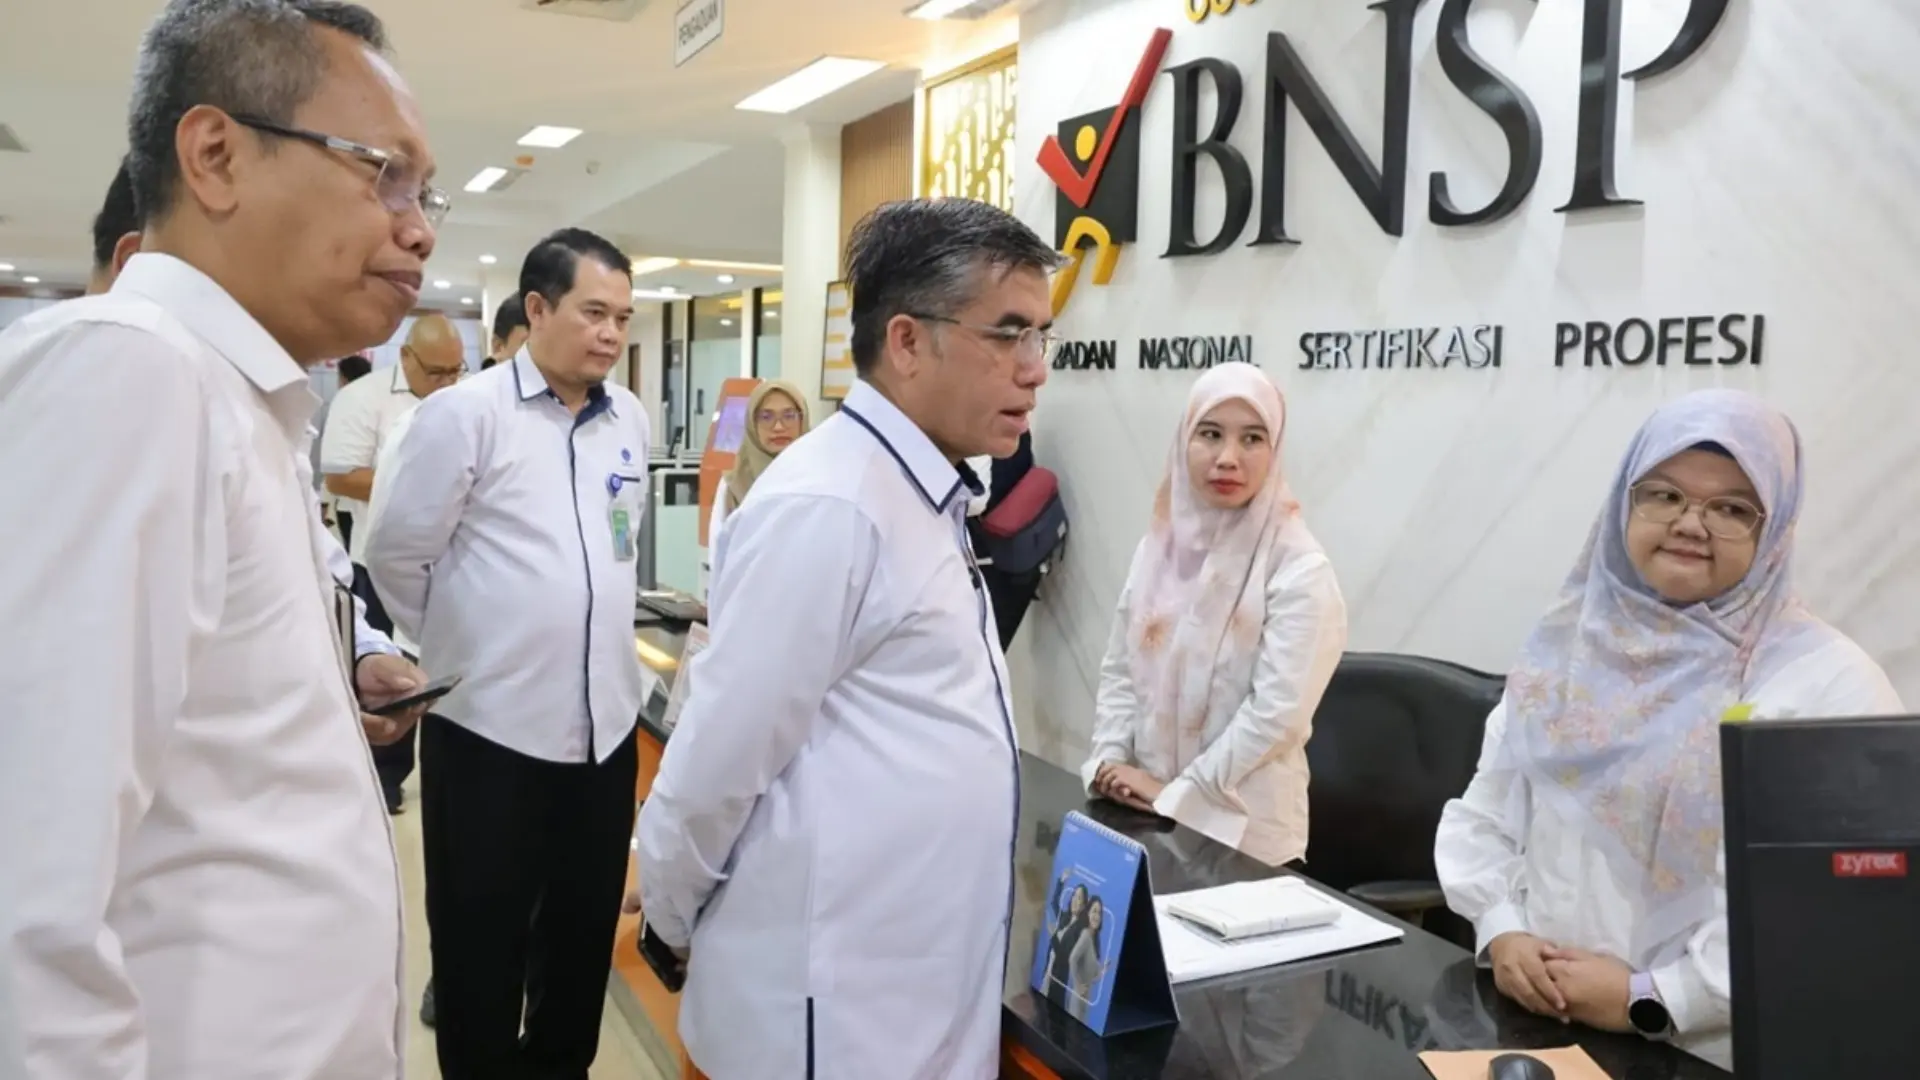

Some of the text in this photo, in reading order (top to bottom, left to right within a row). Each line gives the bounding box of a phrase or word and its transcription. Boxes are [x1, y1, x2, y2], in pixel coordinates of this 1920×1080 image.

[1158, 0, 1729, 258] BNSP
[1138, 335, 1260, 370] NASIONAL
[1298, 325, 1503, 369] SERTIFIKASI
[1554, 314, 1765, 367] PROFESI
